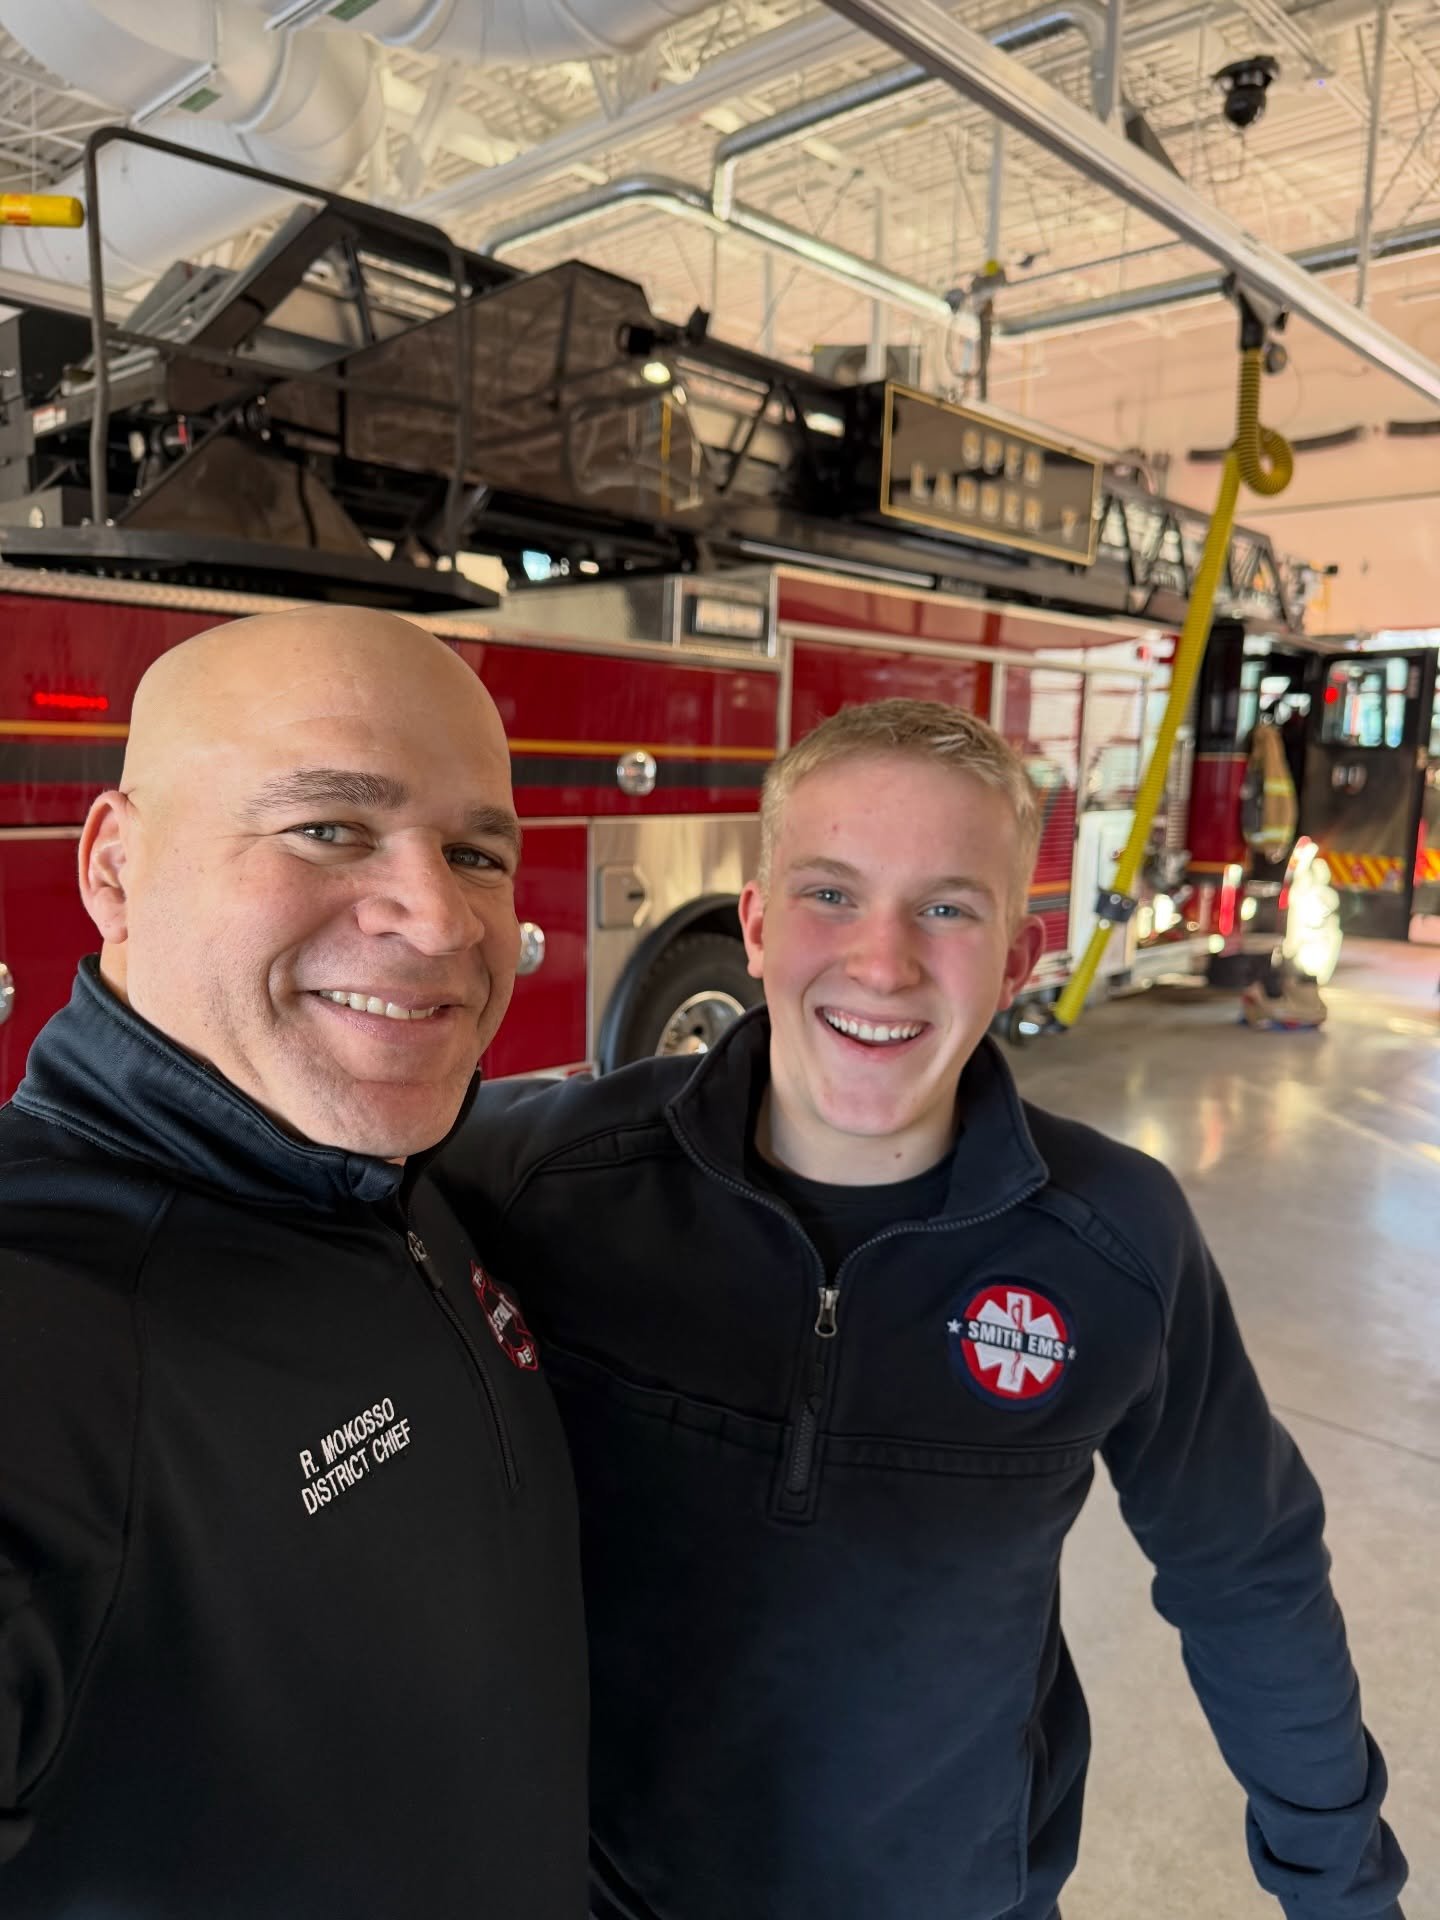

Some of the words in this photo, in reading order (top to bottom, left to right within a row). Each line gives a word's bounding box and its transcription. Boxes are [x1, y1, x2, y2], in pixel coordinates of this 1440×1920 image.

[910, 461, 1041, 536] LADDER
[968, 1320, 1023, 1350] SMITH
[1027, 1335, 1065, 1361] EMS
[299, 1449, 320, 1480] R.
[320, 1397, 395, 1465] MOKOSSO
[301, 1447, 370, 1515] DISTRICT
[372, 1418, 411, 1464] CHIEF
